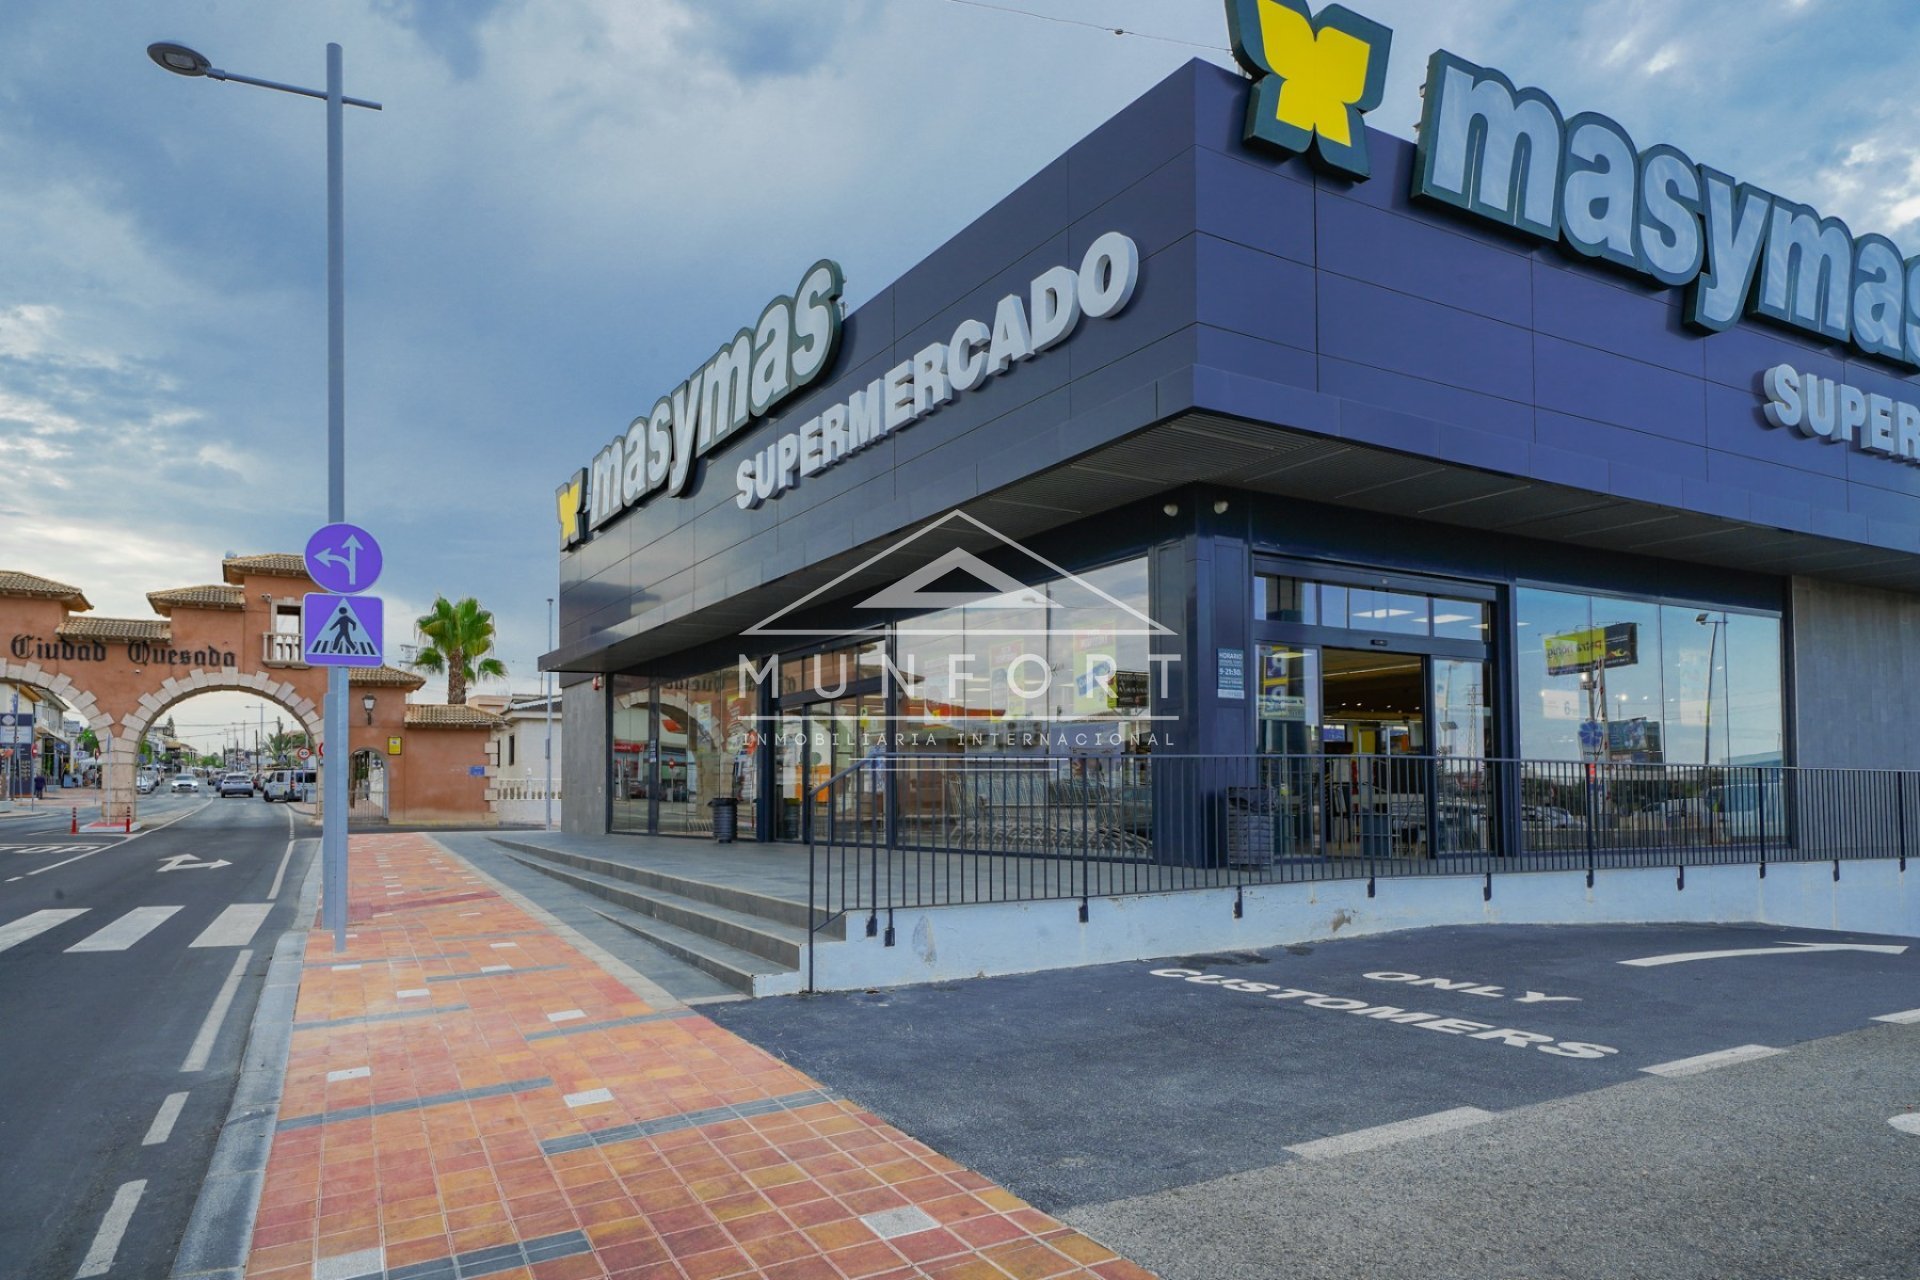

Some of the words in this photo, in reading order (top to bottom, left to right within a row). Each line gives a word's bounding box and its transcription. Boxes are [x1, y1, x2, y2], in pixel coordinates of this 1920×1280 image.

[585, 258, 845, 532] masymas
[736, 231, 1139, 509] SUPERMERCADO
[11, 634, 106, 661] Ciudad
[127, 640, 236, 667] Quesada
[1150, 968, 1618, 1058] CUSTOMERS
[1363, 972, 1582, 1003] ONLY
